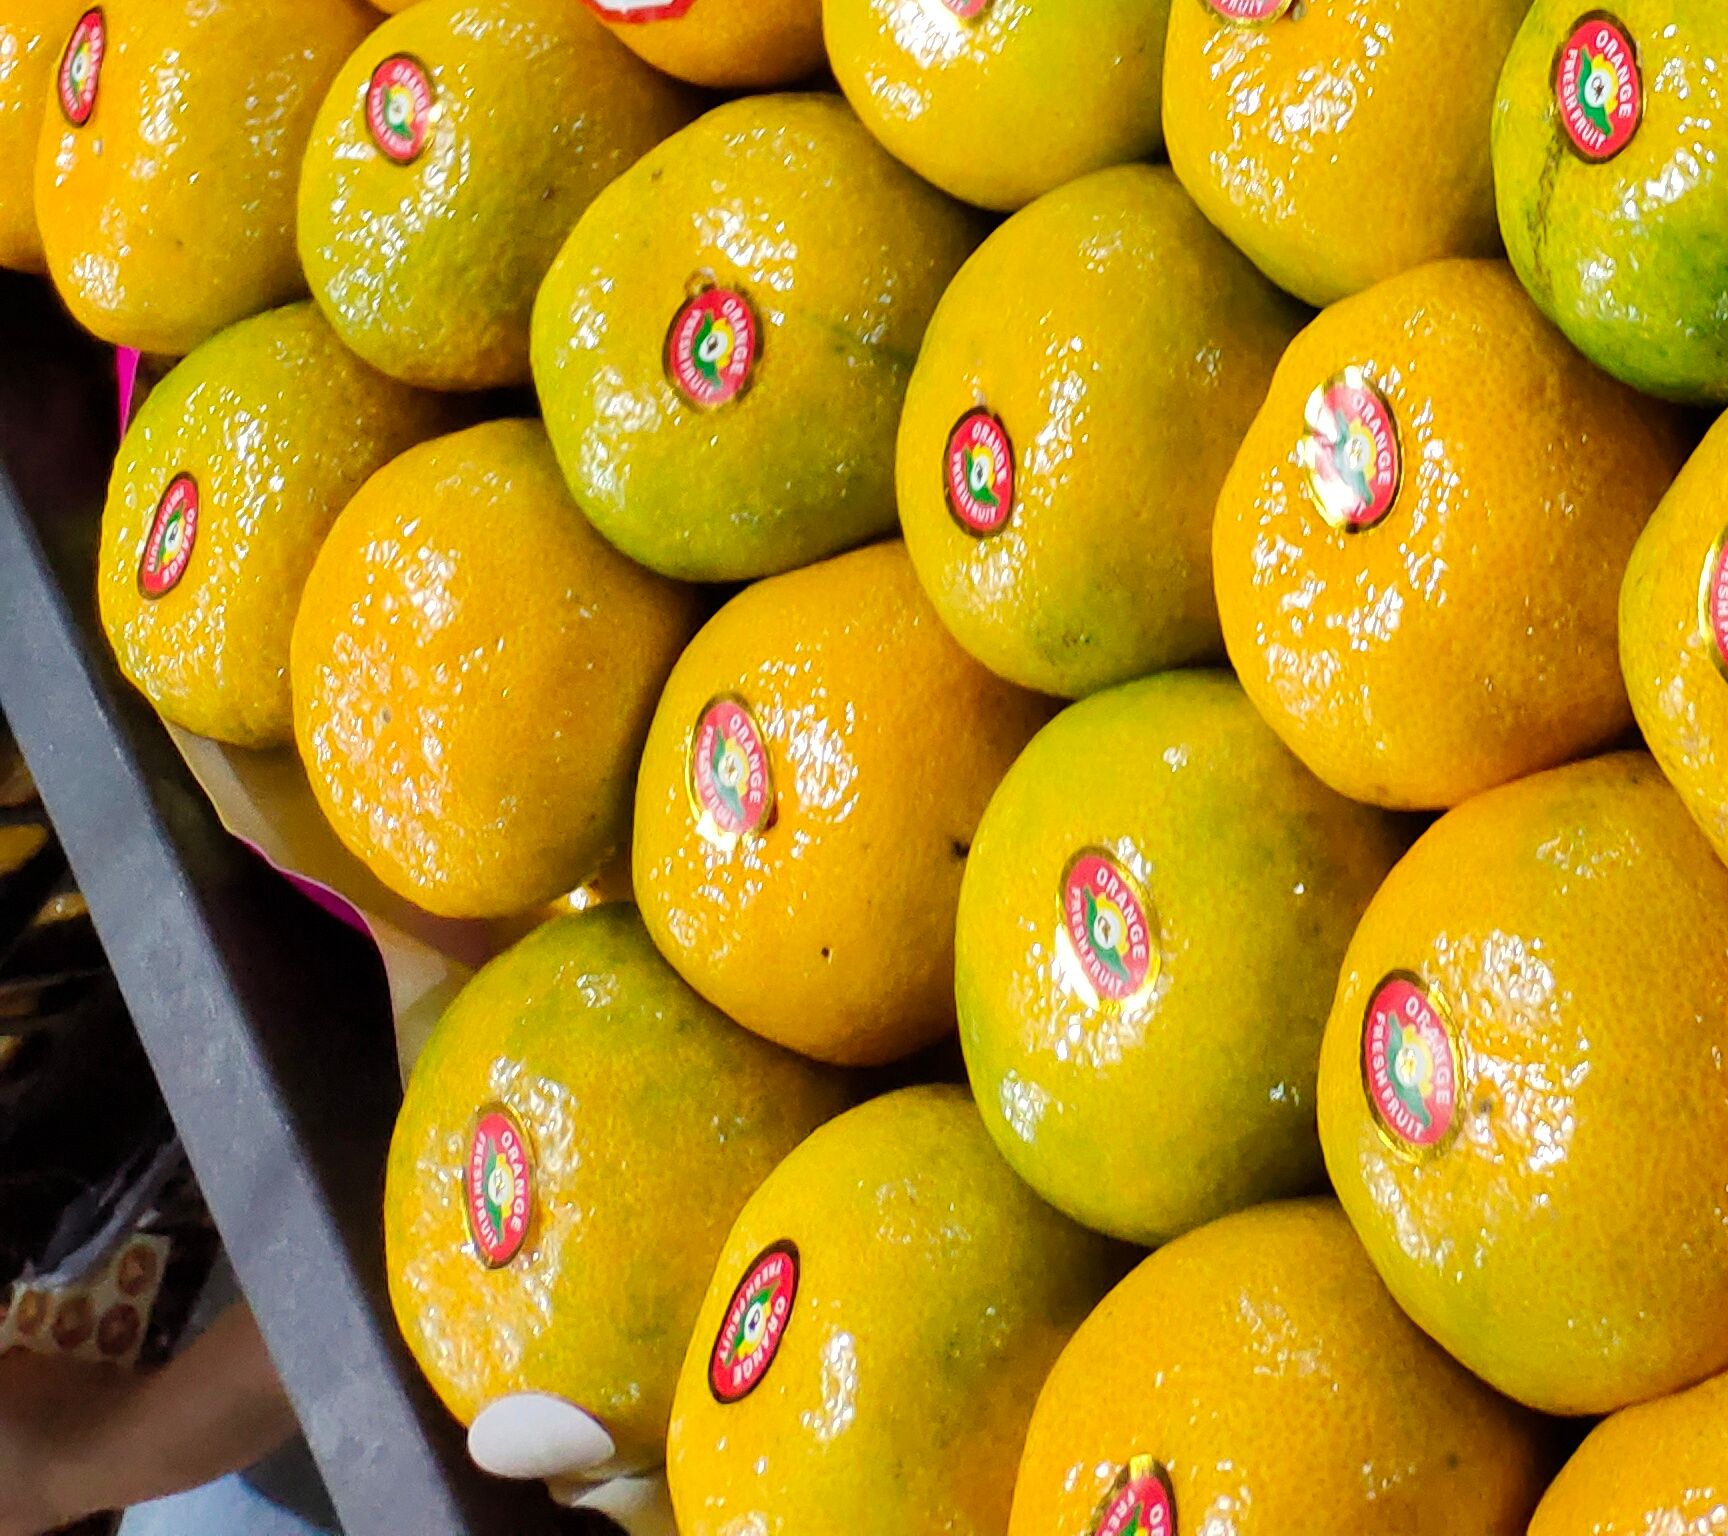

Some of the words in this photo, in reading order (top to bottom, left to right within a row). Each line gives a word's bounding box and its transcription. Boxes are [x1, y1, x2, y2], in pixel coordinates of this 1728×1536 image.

[1595, 29, 1634, 118] ORANGE
[722, 297, 749, 377] ORANGE
[728, 714, 762, 805] ORANGE
[1096, 868, 1147, 961] ORANGE
[1380, 1088, 1424, 1139] FRUIT
[499, 1129, 526, 1231] ORANGE
